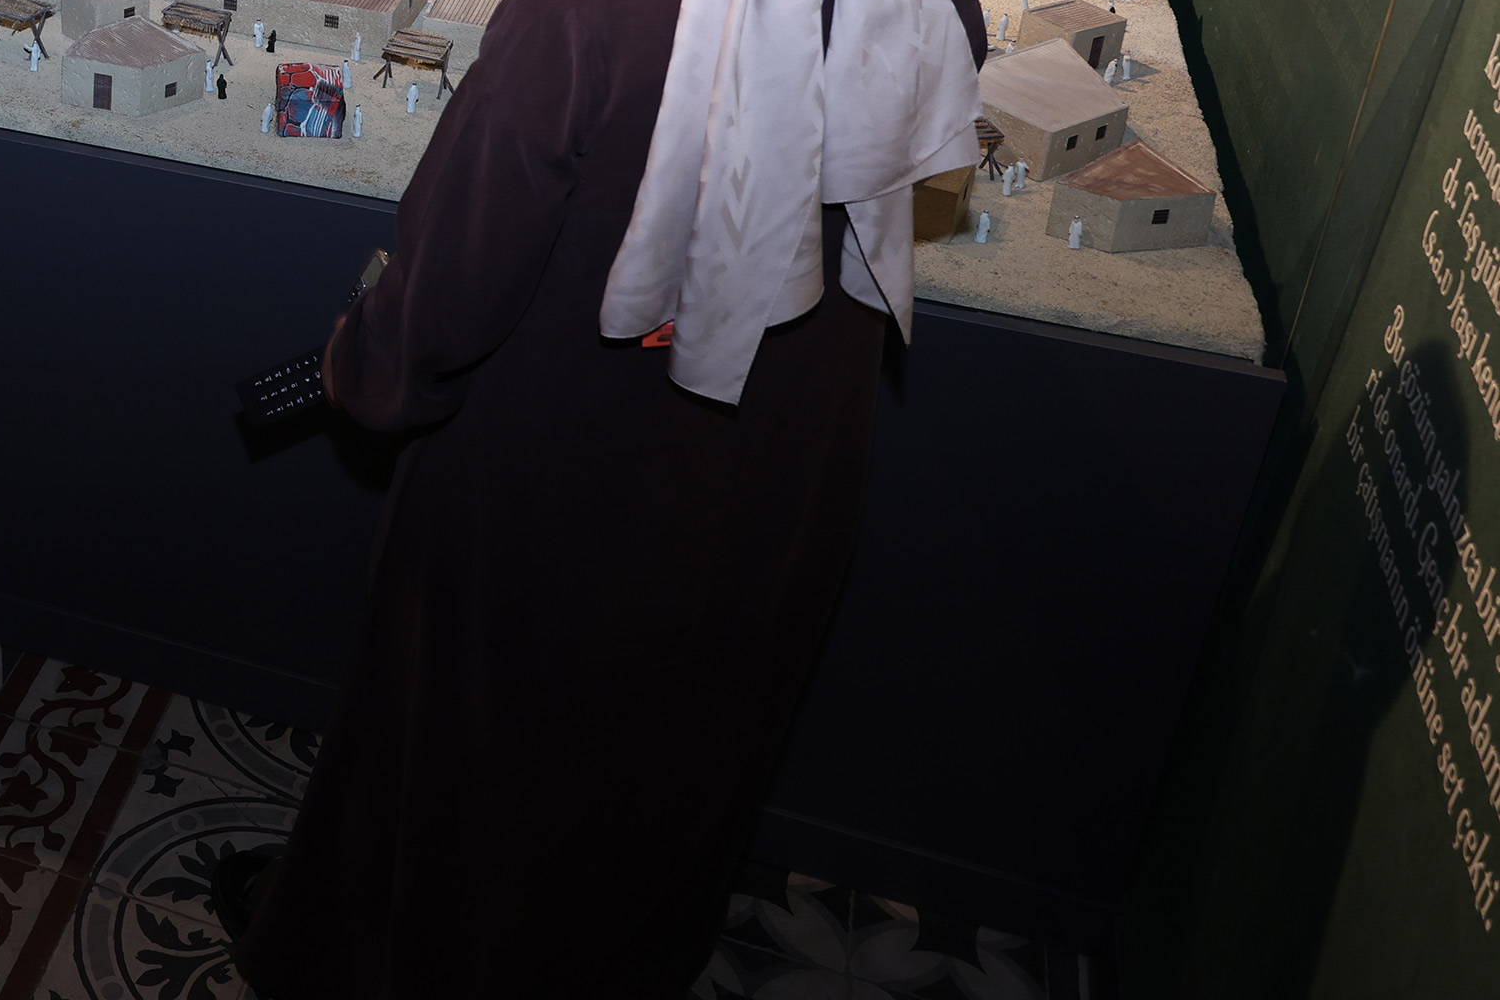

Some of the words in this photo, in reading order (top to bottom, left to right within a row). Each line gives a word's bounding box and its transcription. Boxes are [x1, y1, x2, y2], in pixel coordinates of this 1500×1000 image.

[1456, 180, 1480, 263] Taş
[1365, 368, 1383, 401] ri
[1372, 386, 1391, 436] de
[1383, 303, 1406, 369] Bu
[1396, 359, 1437, 467] çözüm
[1426, 450, 1481, 594] yalnızca
[1474, 566, 1500, 647] bir
[1383, 428, 1423, 539] onardı.
[1416, 520, 1451, 636] Genç
[1345, 404, 1365, 464] bir
[1404, 616, 1444, 747] önüne
[1436, 742, 1466, 816] set
[1451, 807, 1500, 933] çekti.
[1441, 602, 1470, 680] bir
